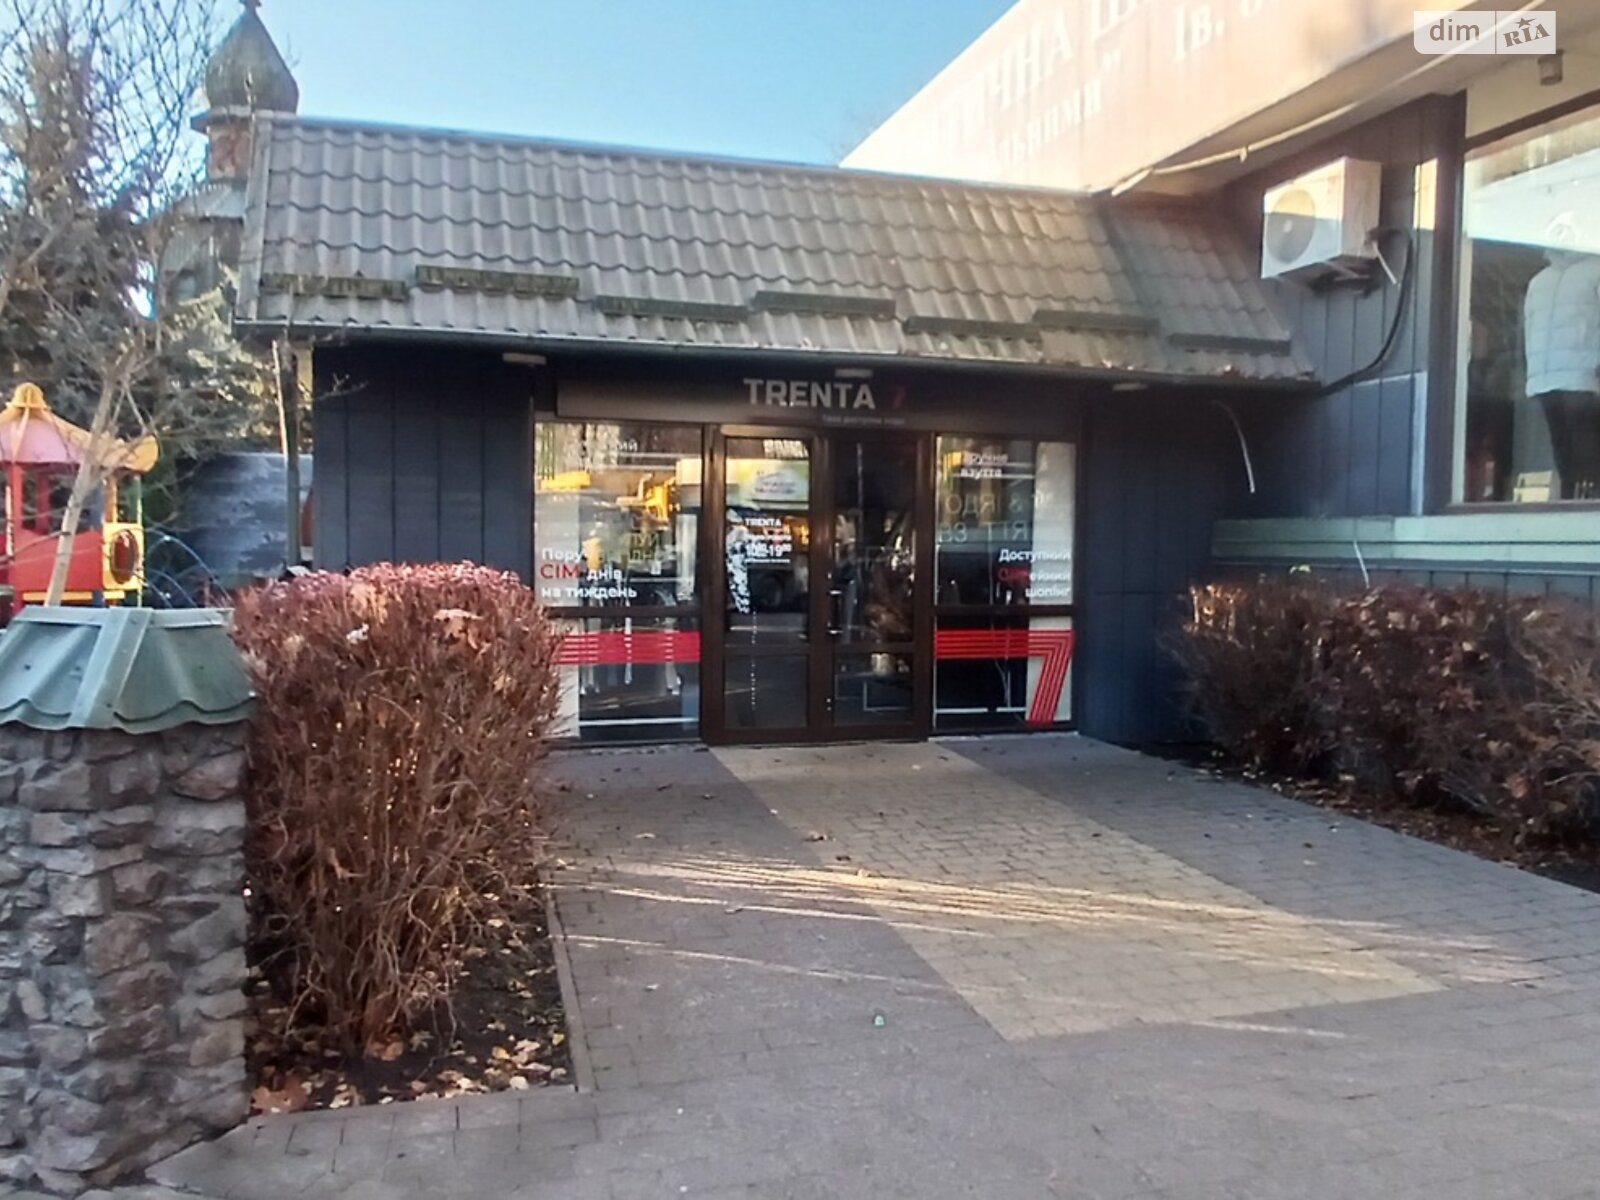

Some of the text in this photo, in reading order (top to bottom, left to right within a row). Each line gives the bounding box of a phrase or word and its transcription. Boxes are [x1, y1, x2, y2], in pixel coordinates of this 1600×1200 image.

[743, 378, 875, 410] TRENTA
[587, 564, 623, 581] днів
[541, 586, 638, 600] на тиждень
